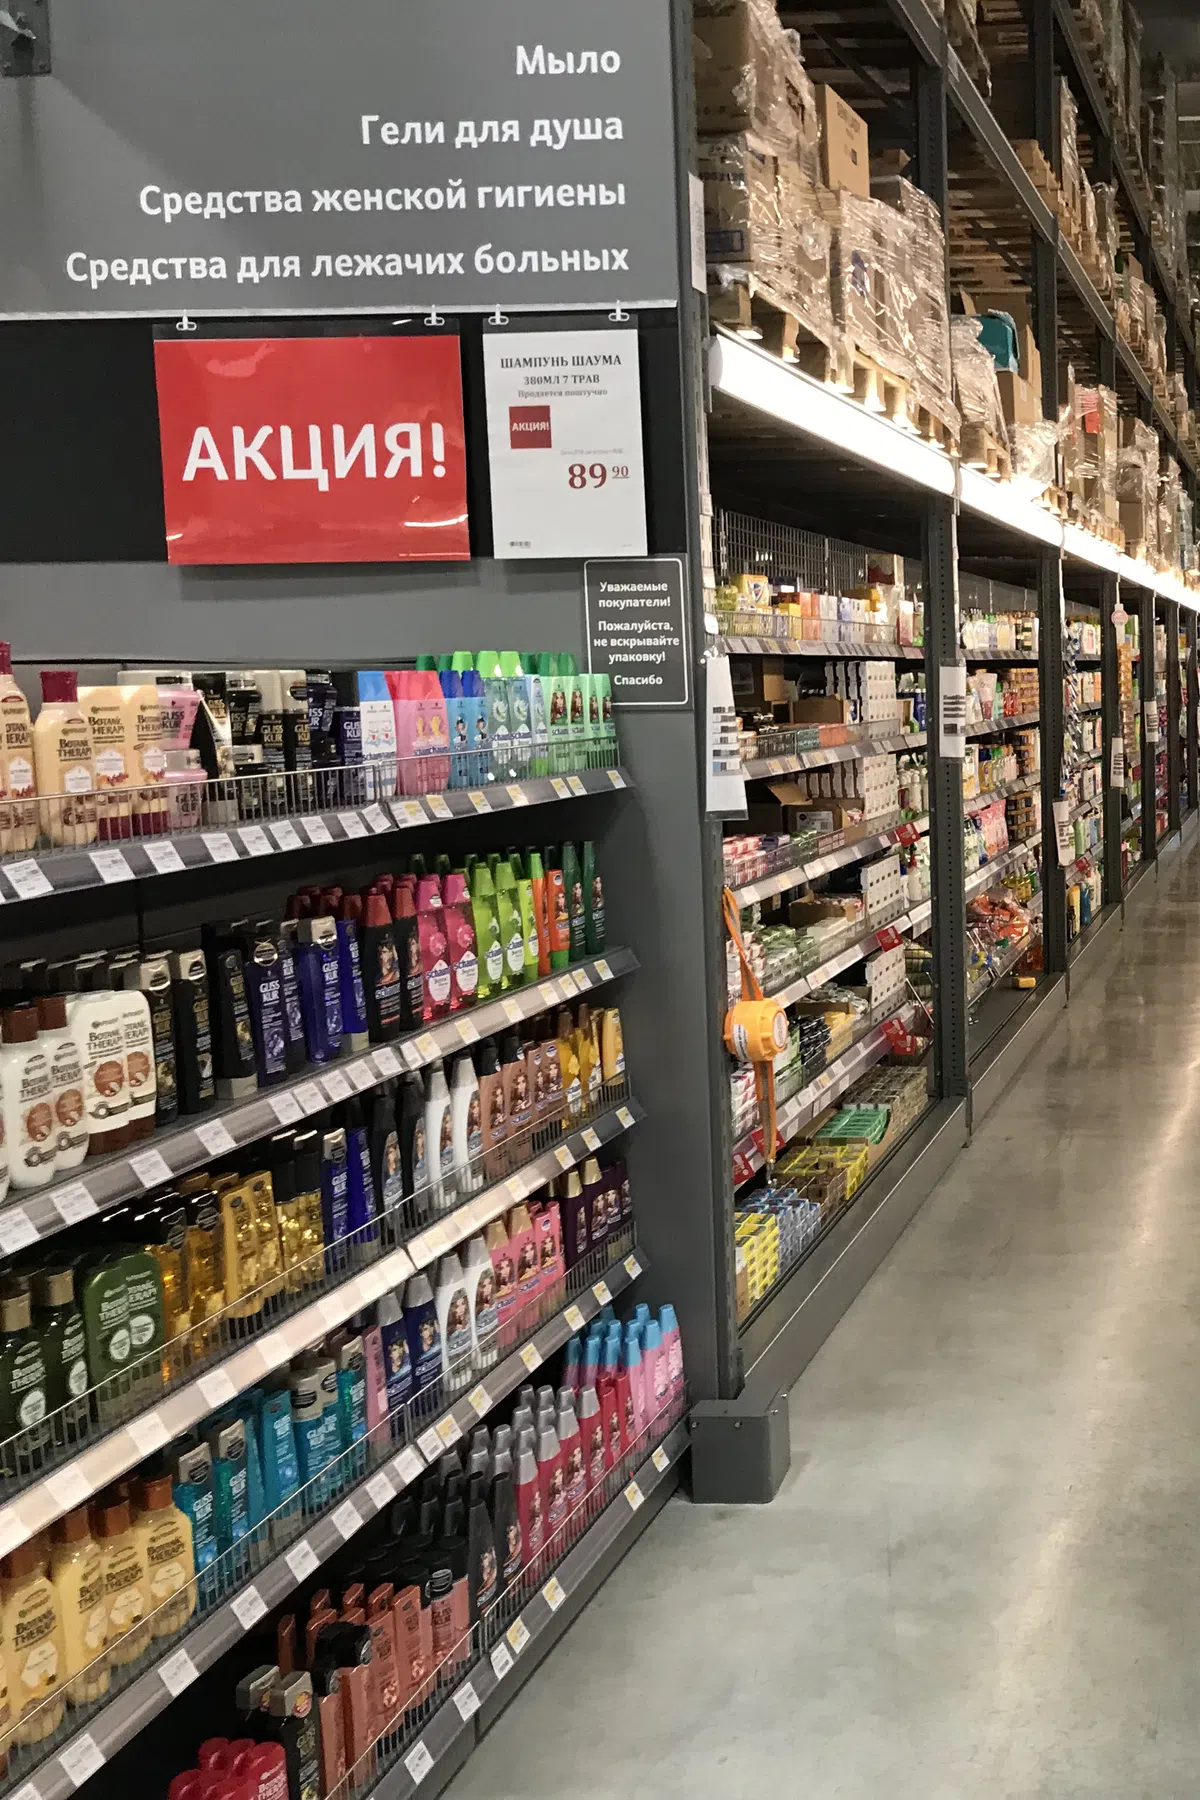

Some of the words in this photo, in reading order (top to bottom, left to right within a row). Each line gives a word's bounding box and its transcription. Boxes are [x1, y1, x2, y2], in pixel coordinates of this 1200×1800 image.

[516, 45, 621, 76] Мыло
[361, 114, 444, 145] Гели
[455, 120, 520, 149] для
[529, 116, 624, 150] душа
[139, 184, 302, 222] Средства
[312, 179, 466, 213] женской
[478, 182, 625, 209] гигиены
[66, 251, 227, 288] Средства
[237, 256, 301, 284] для
[311, 250, 465, 278] лежачих
[474, 244, 629, 274] больных
[500, 356, 568, 369] ШАМПУНЬ
[571, 354, 622, 367] ШАУМА
[523, 375, 561, 386] 380МЛ
[562, 375, 568, 385] 7
[571, 374, 600, 384] ТРАВ
[512, 422, 550, 433] АКЦИЯ!
[182, 422, 446, 491] АКЦИЯ!
[568, 463, 607, 489] 89
[612, 466, 629, 478] 90
[600, 581, 668, 593] Уважаемые
[598, 597, 671, 609] покупатели!
[598, 620, 673, 633] Пожалуйста,
[594, 637, 608, 647] не
[611, 634, 680, 649] вскрывайте
[609, 652, 666, 665] упаковку!
[614, 674, 663, 685] Спасибо
[261, 725, 284, 734] GLISS
[263, 733, 283, 743] KUR
[259, 979, 280, 993] GLISS
[262, 990, 279, 1003] KUR
